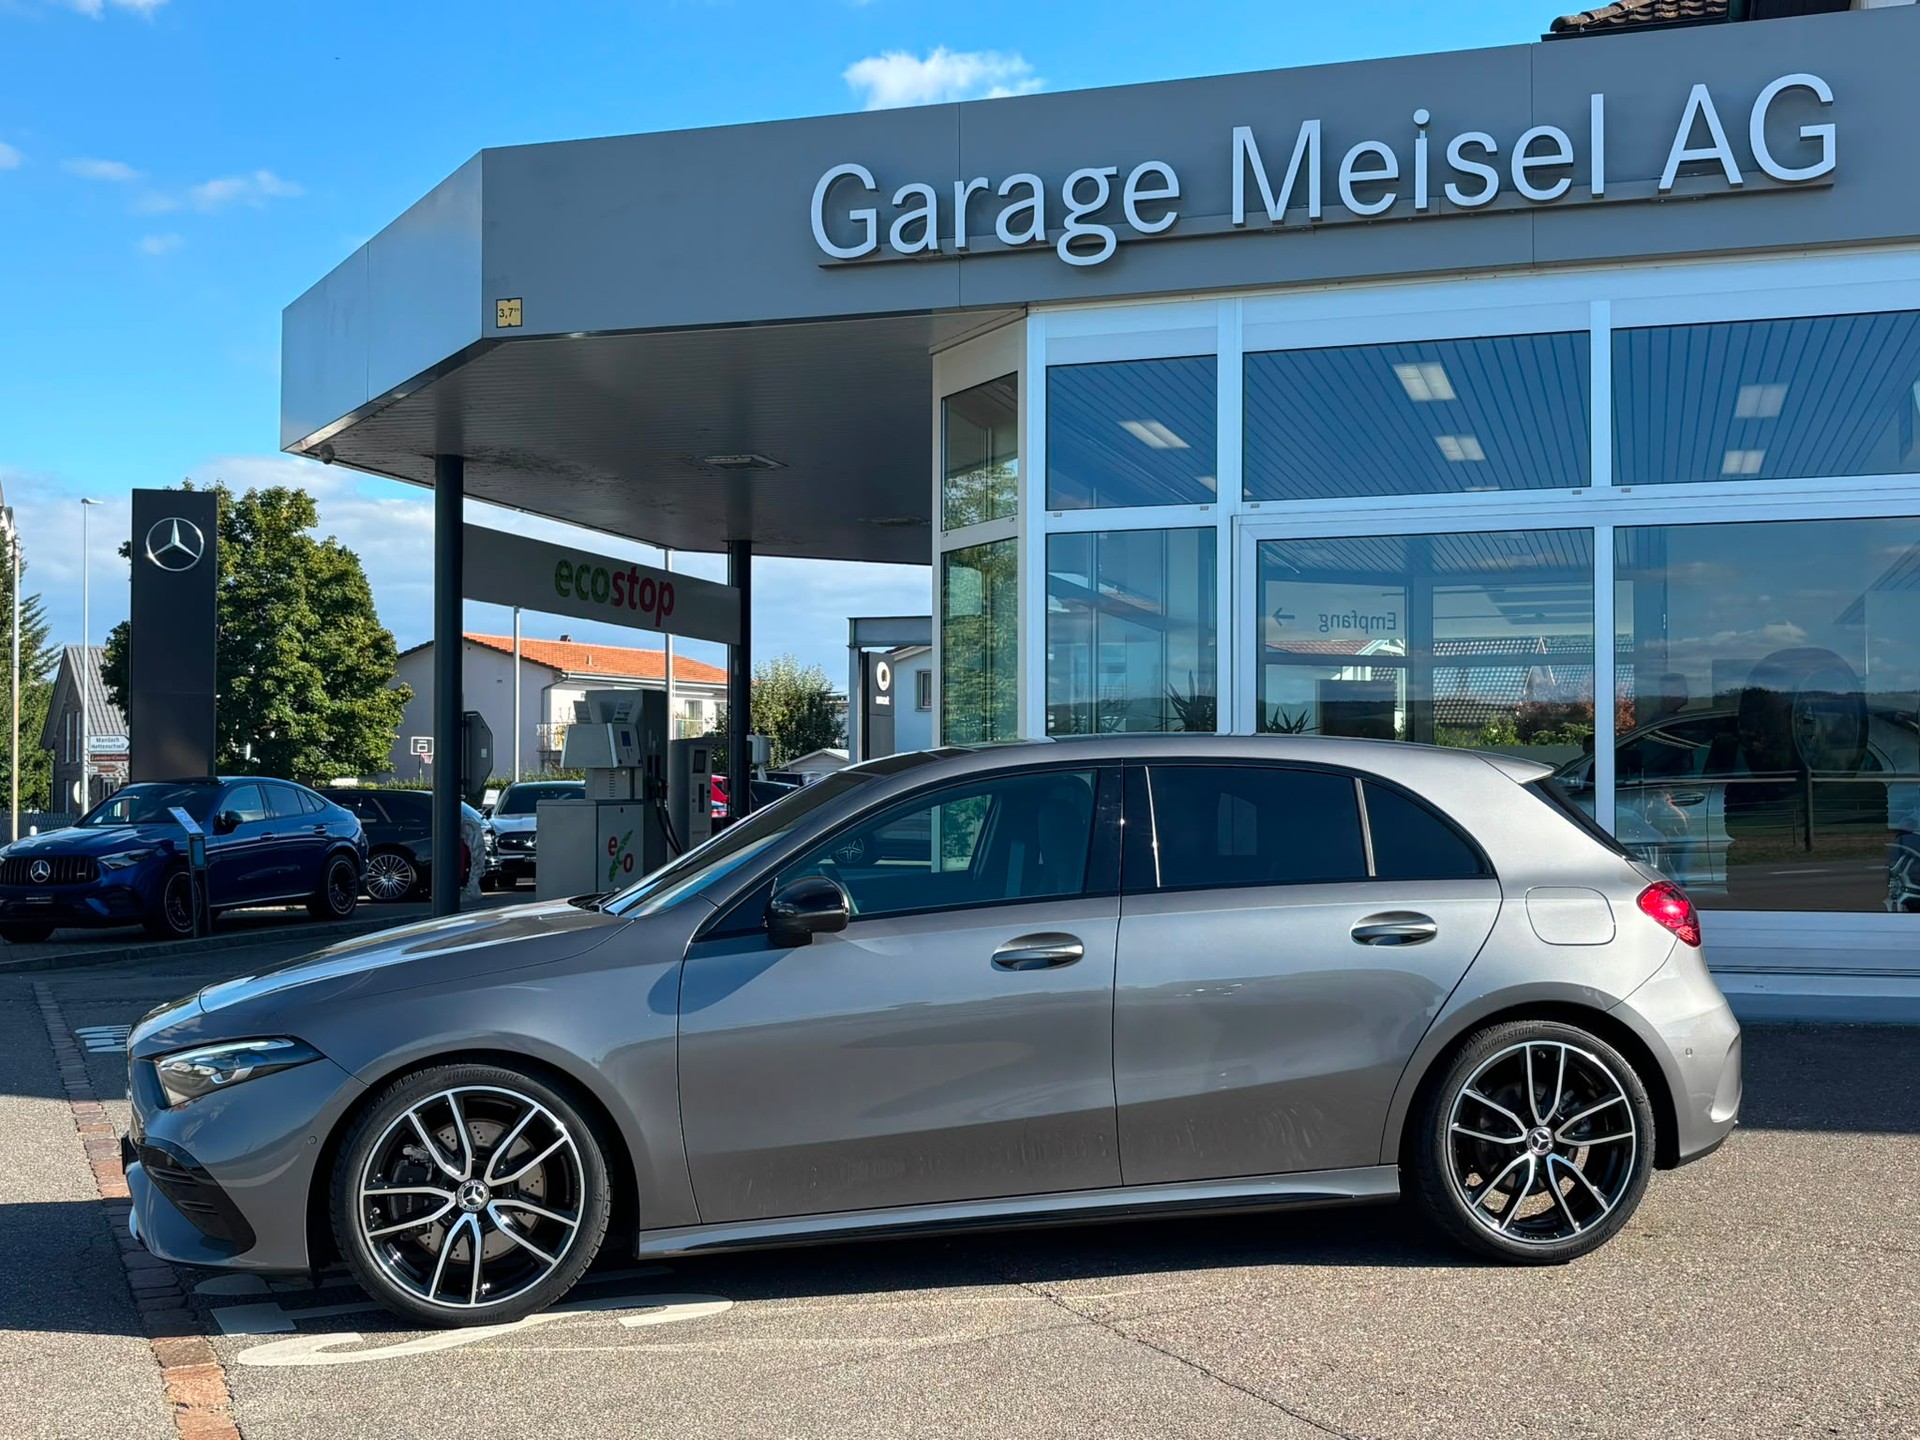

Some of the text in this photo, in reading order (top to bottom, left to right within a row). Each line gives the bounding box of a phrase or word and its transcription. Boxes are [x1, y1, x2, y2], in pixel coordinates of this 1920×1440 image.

[811, 73, 1837, 266] Garage Meisel AG
[554, 559, 675, 628] ecostop
